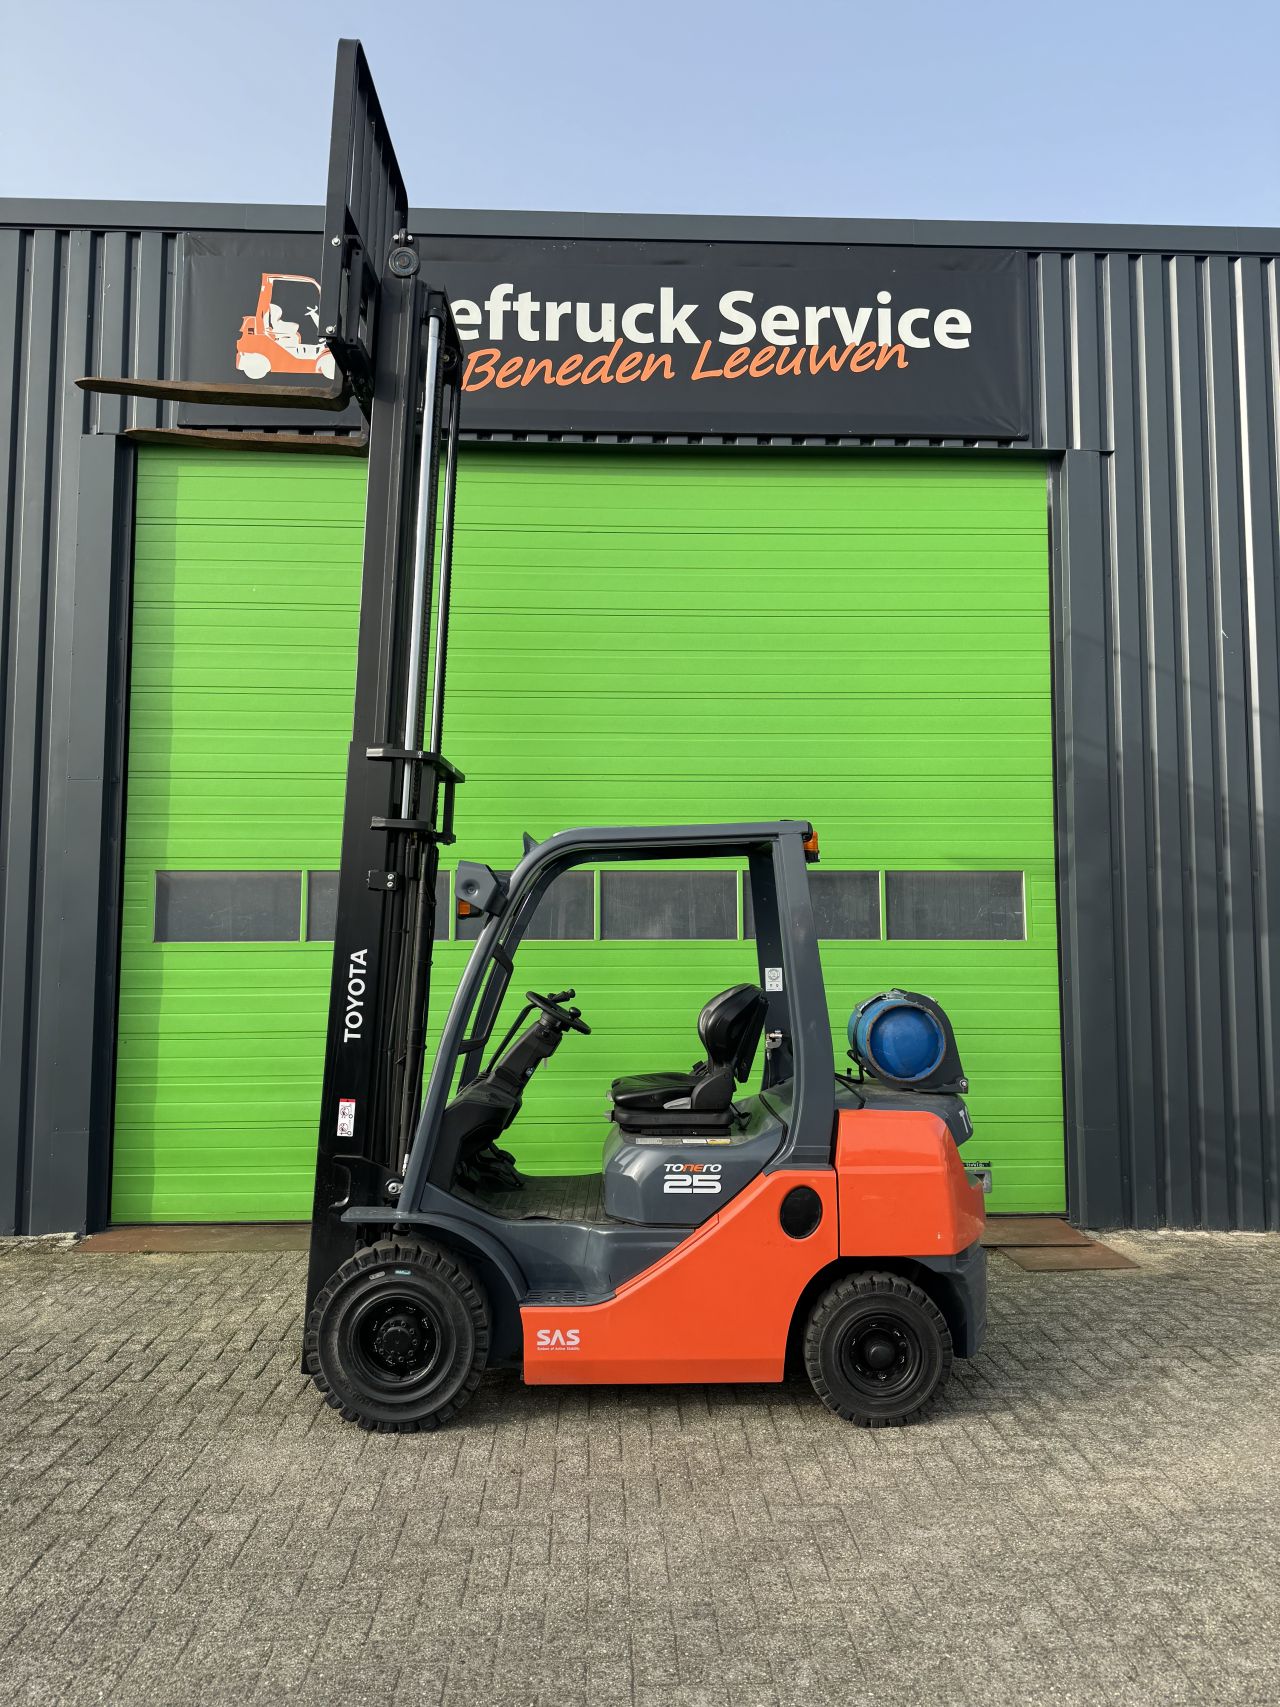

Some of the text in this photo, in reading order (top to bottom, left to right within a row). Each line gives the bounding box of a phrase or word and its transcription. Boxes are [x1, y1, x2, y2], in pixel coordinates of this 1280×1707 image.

[450, 283, 972, 349] eftruck Service
[461, 337, 909, 392] Beneden Leeuwen
[343, 948, 368, 1043] TOYOTA
[663, 1174, 722, 1194] 25
[536, 1329, 580, 1346] SAS
